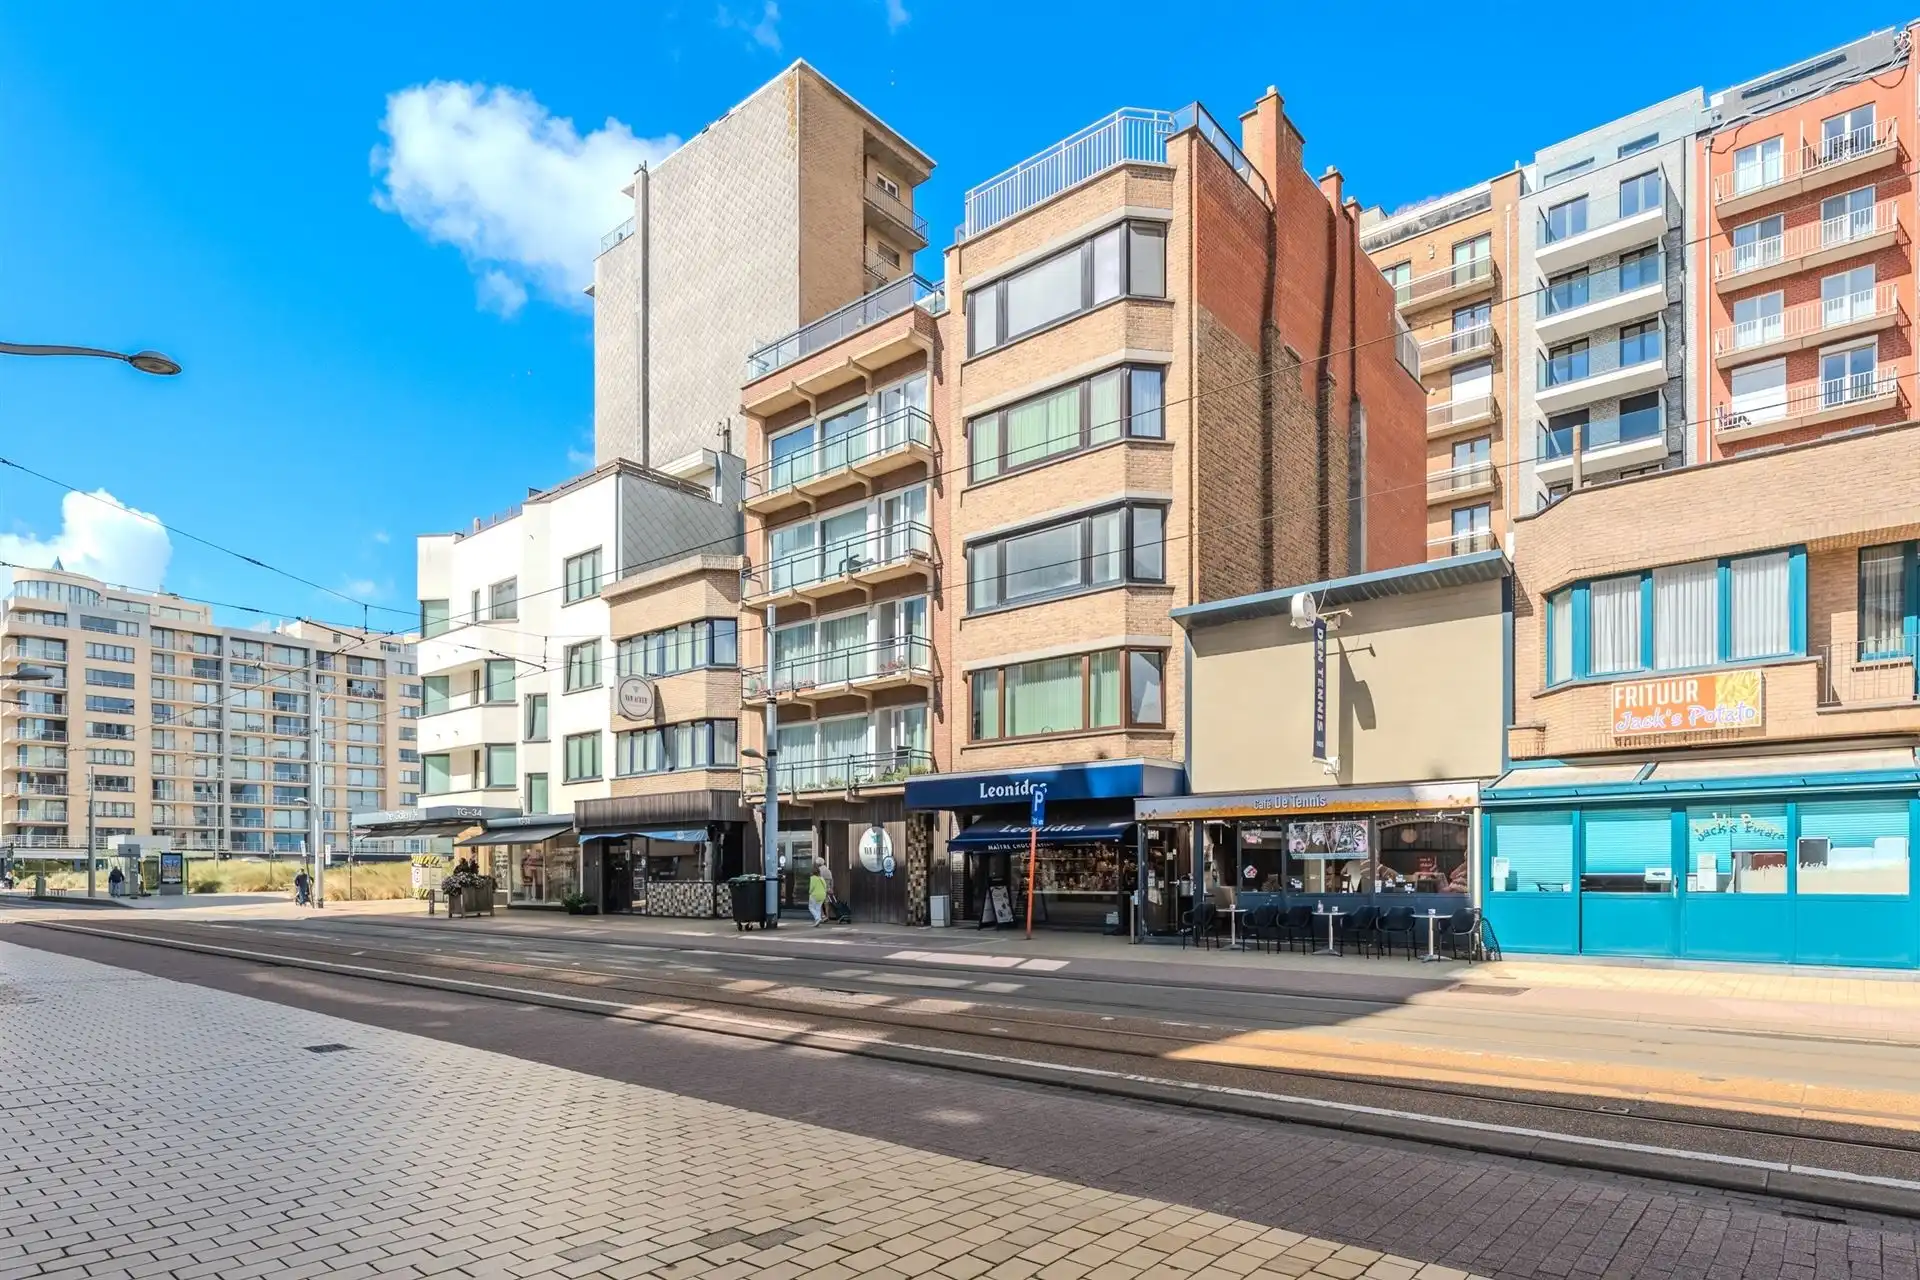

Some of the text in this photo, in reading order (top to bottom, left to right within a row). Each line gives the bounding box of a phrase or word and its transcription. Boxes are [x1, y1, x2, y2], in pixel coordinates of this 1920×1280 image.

[1316, 627, 1324, 663] DEN
[1614, 678, 1699, 709] FRITUUR
[1615, 702, 1756, 731] Jack's Potato
[980, 779, 1047, 798] Leonidas
[1034, 790, 1044, 812] P
[1253, 798, 1273, 810] Café
[1290, 793, 1327, 808] Tennis
[456, 807, 483, 817] TG-34
[999, 824, 1086, 833] Leonidas
